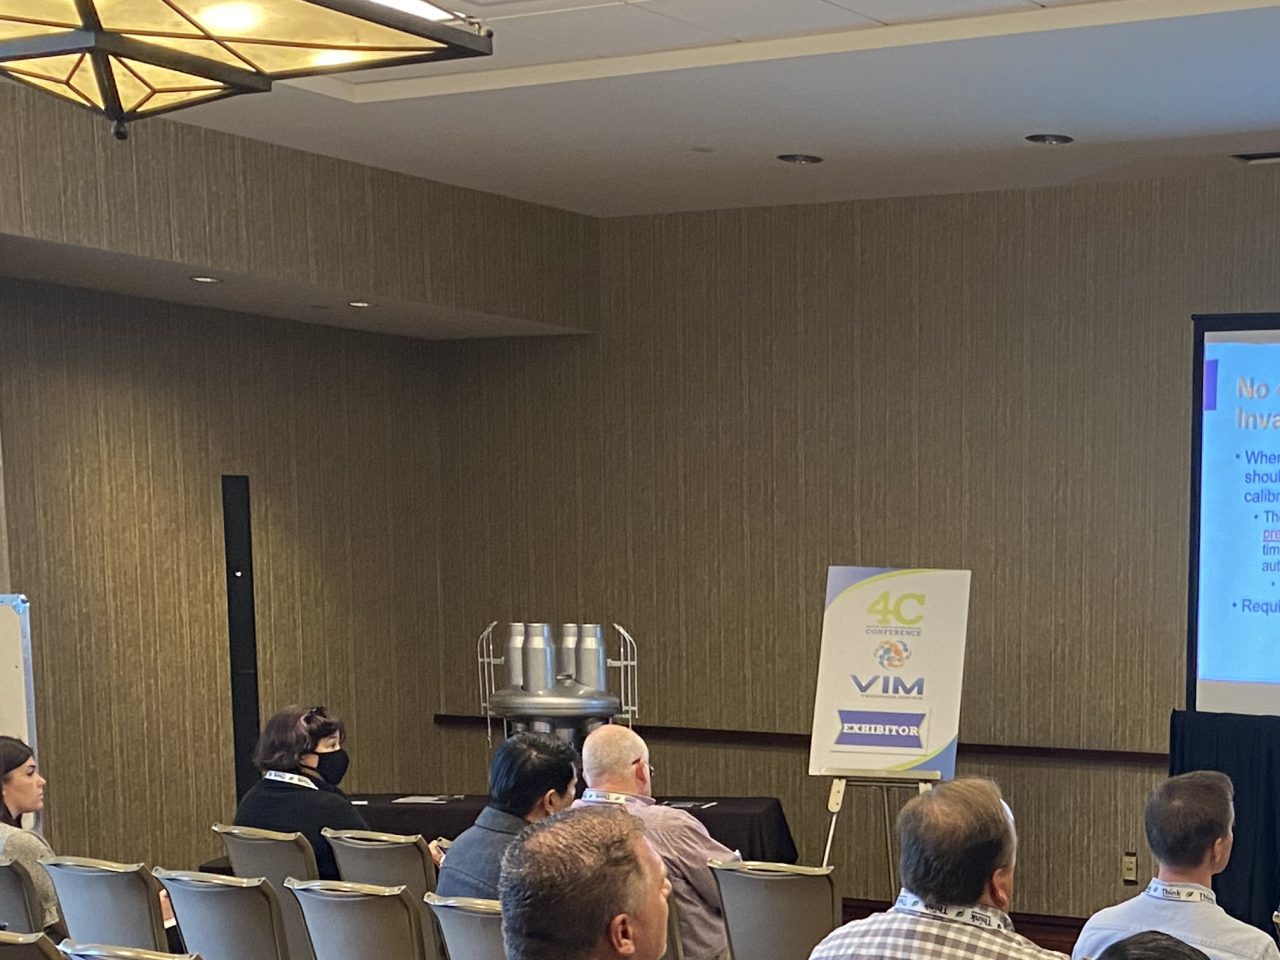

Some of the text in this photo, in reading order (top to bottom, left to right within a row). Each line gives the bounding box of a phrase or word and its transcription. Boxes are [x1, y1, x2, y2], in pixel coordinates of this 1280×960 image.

[1238, 376, 1269, 399] No
[866, 591, 926, 625] 4C
[865, 629, 922, 637] CONFERENCE
[850, 674, 925, 695] VIM
[843, 723, 918, 736] EXHIBITOR
